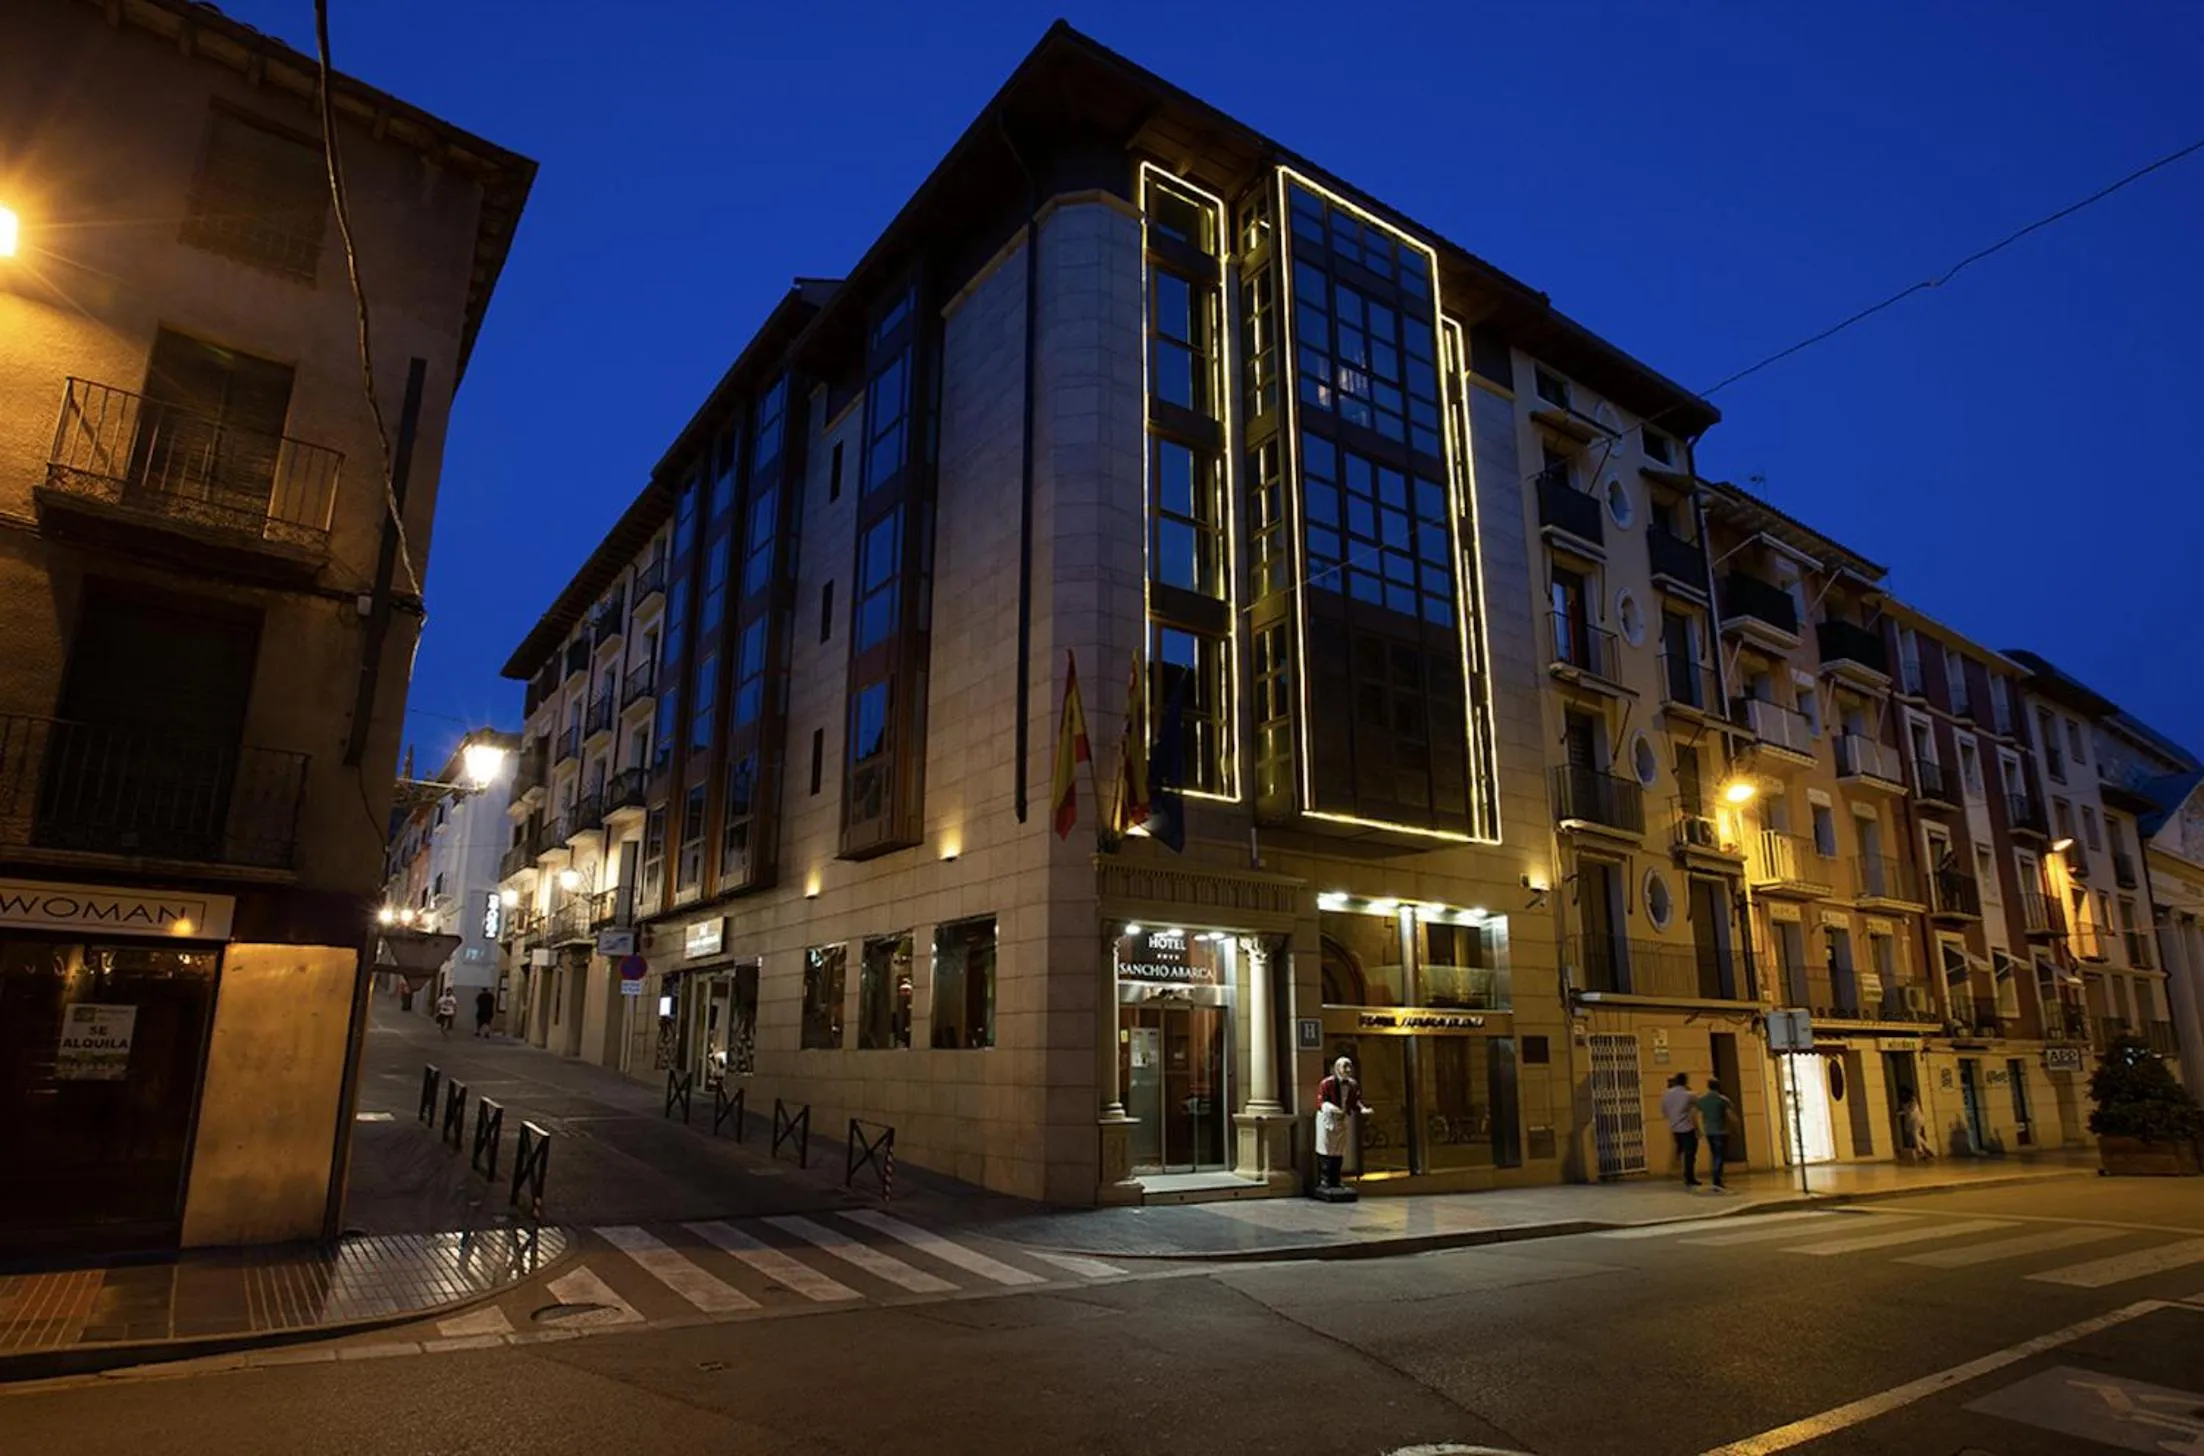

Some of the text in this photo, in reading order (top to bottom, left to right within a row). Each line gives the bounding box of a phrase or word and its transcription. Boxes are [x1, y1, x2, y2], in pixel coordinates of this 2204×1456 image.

[0, 893, 187, 924] WOMAN
[1148, 936, 1186, 951] HOTEL
[1119, 962, 1214, 979] SANCHO ABARCA
[89, 1026, 108, 1036] SE
[63, 1038, 128, 1049] ALQUILA
